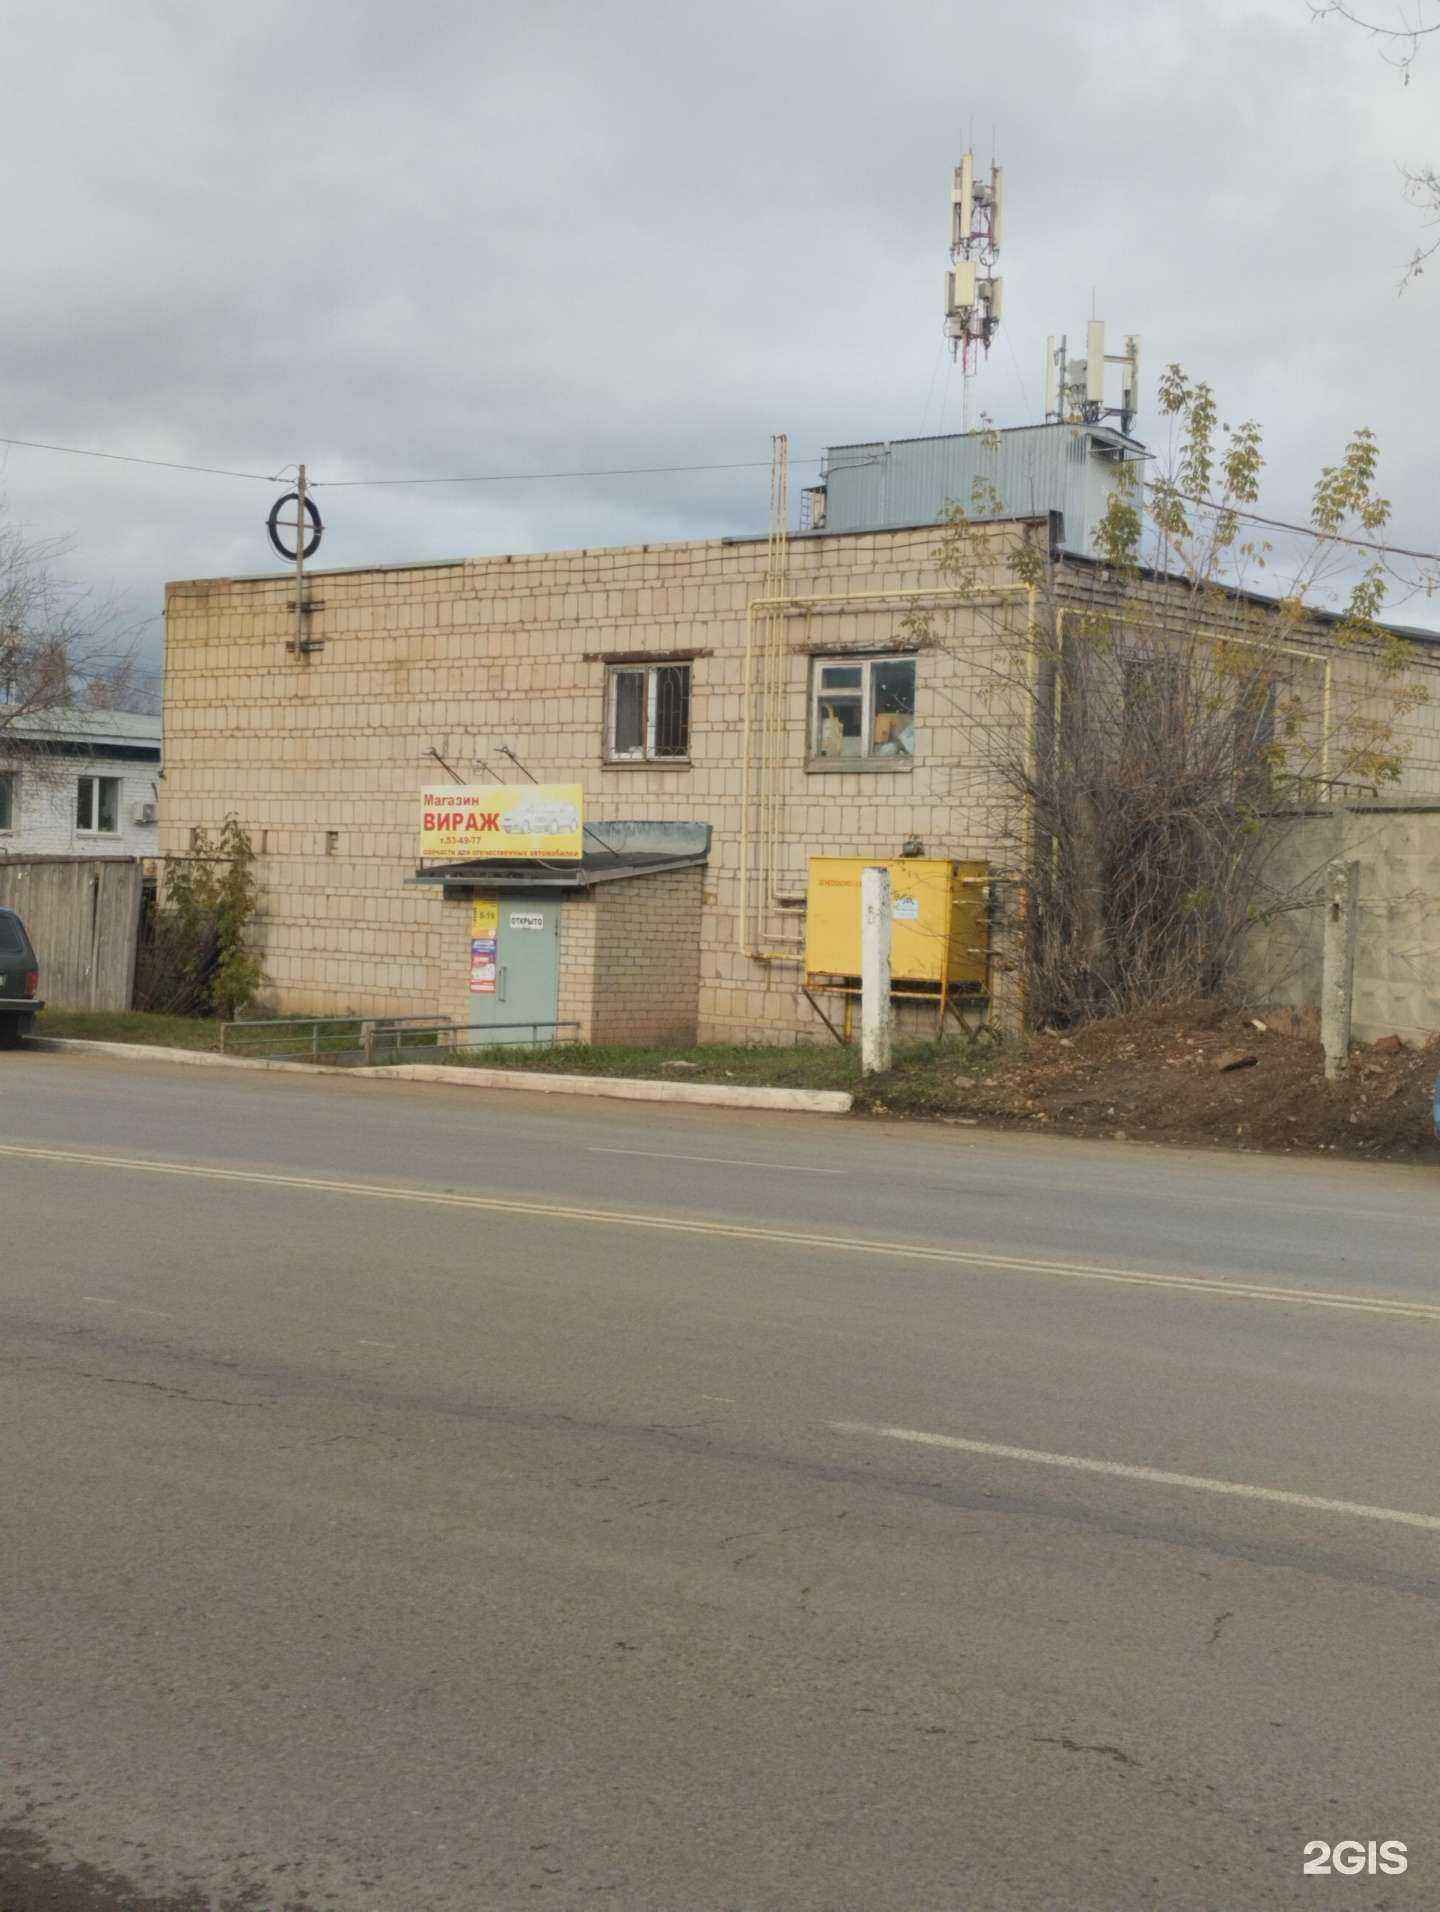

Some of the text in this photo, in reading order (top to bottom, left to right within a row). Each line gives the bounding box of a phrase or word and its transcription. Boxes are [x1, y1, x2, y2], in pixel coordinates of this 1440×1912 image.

[424, 794, 480, 806] Магазин
[424, 812, 500, 832] ВИРАЖ
[511, 917, 543, 926] ОТКРЫТО
